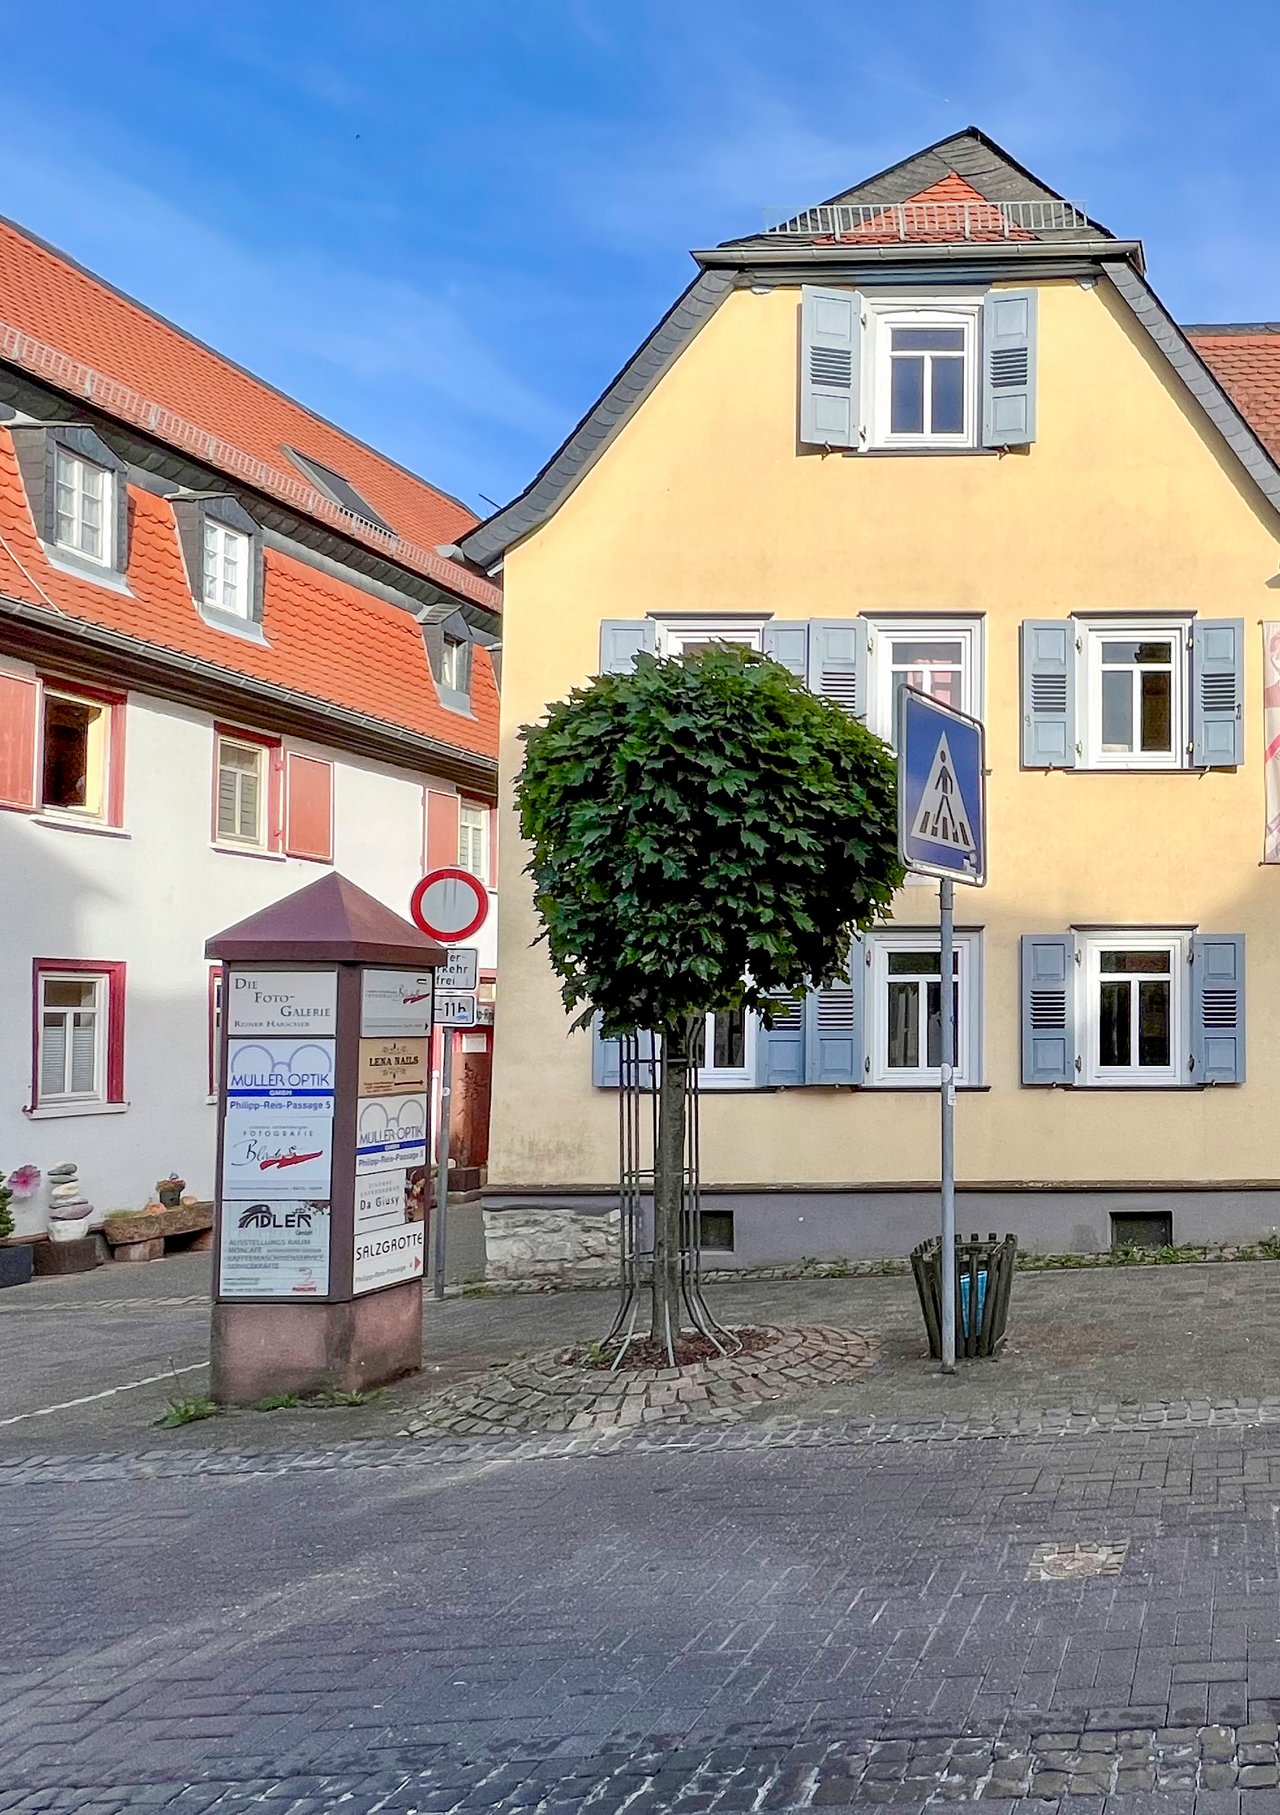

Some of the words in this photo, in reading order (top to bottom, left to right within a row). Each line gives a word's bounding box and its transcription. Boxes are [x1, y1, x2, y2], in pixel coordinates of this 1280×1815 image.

[235, 978, 258, 989] DIE
[436, 976, 455, 986] frei
[254, 991, 295, 1003] FOTO-
[280, 1005, 331, 1017] GALERIE
[369, 1057, 392, 1067] LENA
[394, 1056, 419, 1065] NAILS
[288, 1073, 330, 1087] OPTIK
[230, 1101, 324, 1110] Philipp-Reis-Passage
[325, 1100, 331, 1109] 5
[397, 1126, 424, 1140] OPTIK
[360, 1199, 371, 1211] Da
[375, 1196, 400, 1208] Giusy
[238, 1206, 311, 1228] ADLER
[356, 1232, 422, 1261] SALZGROTTE
